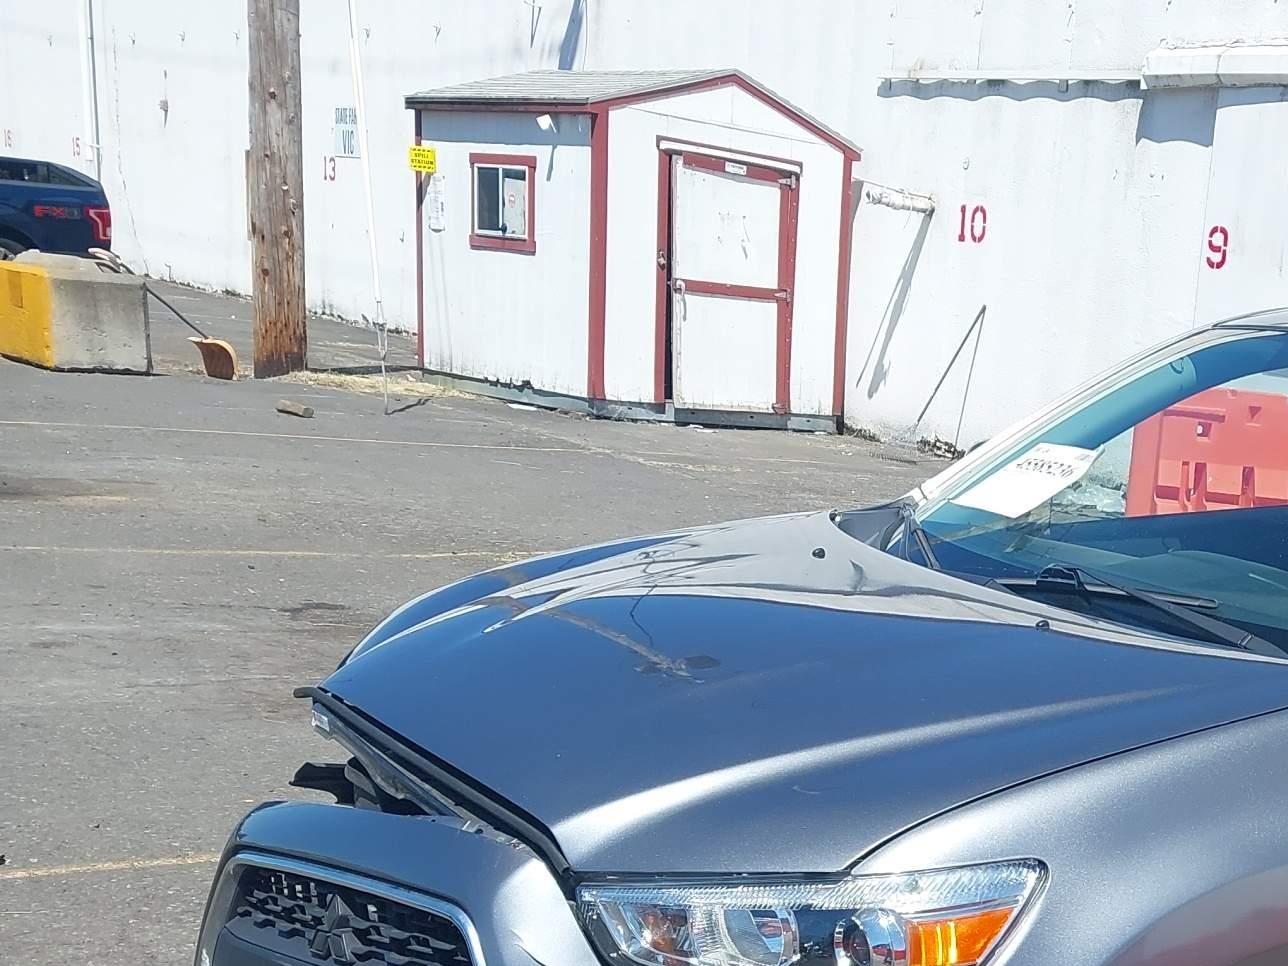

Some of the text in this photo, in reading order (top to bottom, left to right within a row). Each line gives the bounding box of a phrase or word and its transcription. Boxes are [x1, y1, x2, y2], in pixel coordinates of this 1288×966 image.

[324, 155, 336, 181] 13
[958, 204, 987, 244] 10
[1206, 226, 1230, 270] 9
